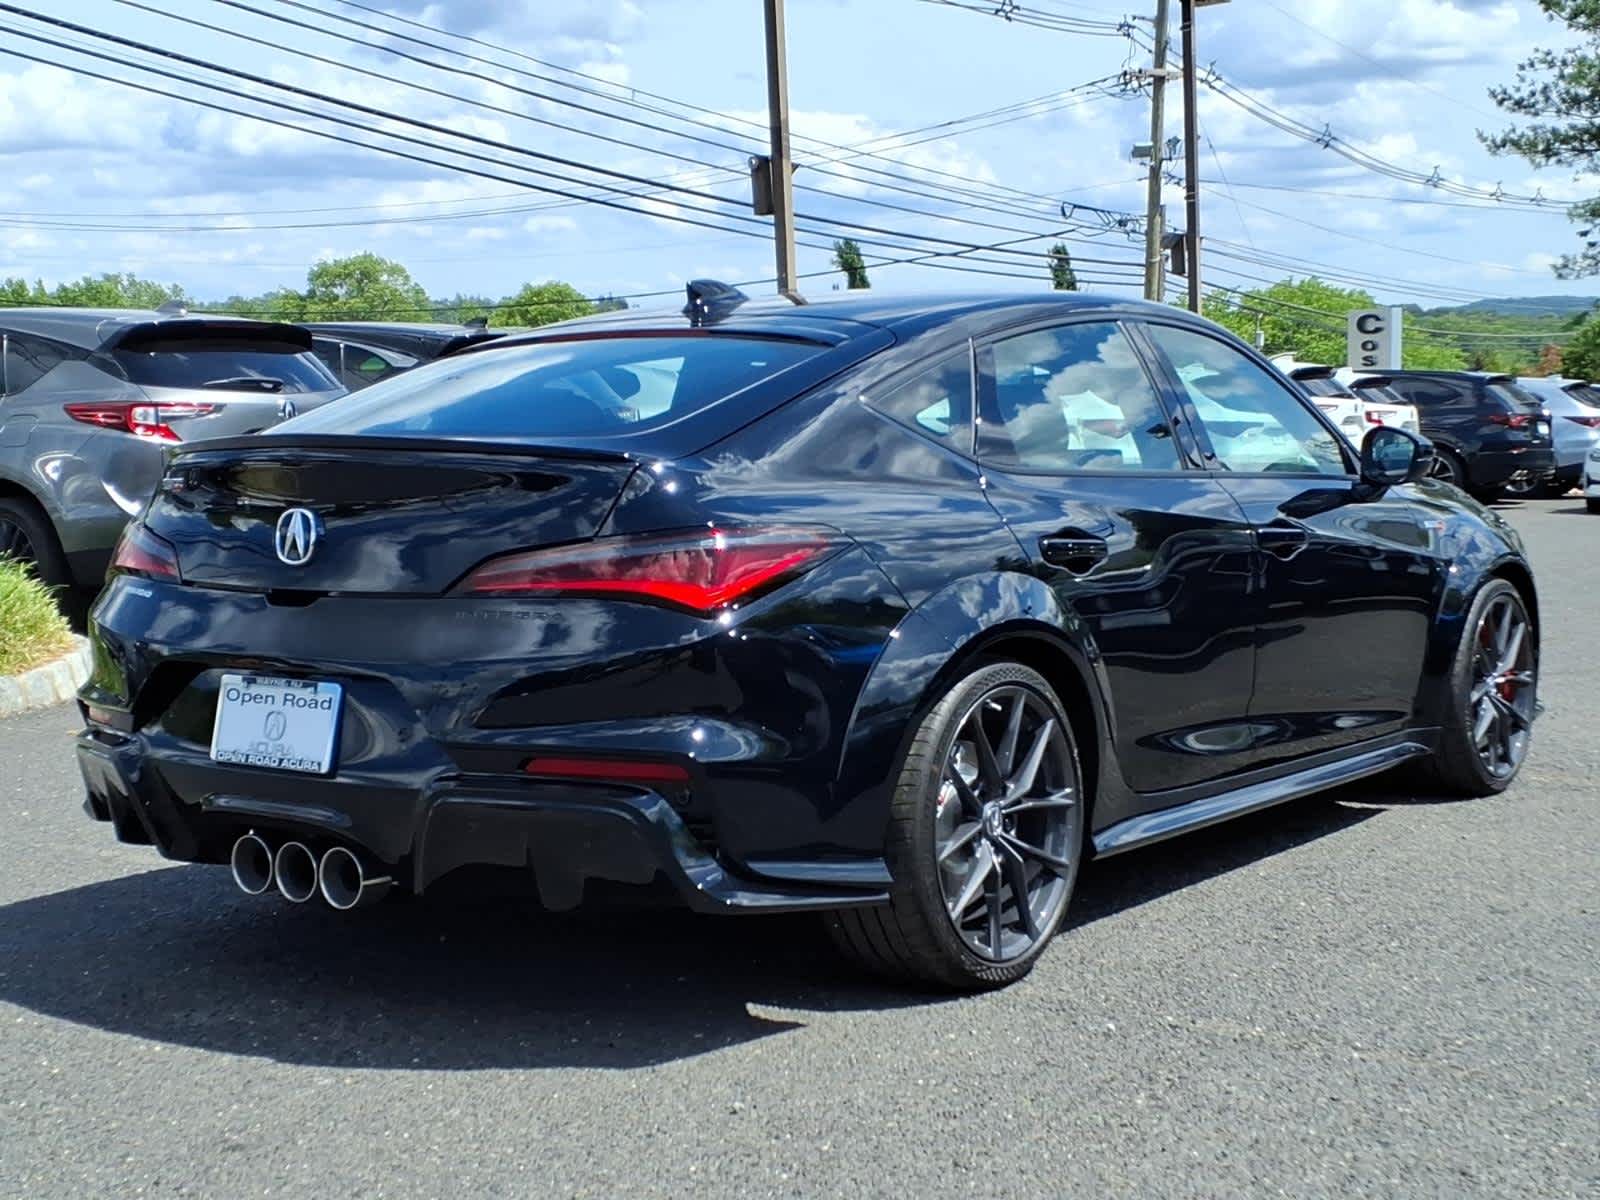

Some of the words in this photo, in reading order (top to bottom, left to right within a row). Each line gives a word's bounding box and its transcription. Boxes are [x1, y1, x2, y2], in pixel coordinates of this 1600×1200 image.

[226, 688, 276, 706] Open
[282, 693, 333, 711] Road
[217, 751, 246, 762] OPEN
[248, 755, 279, 767] ROAD
[281, 758, 320, 771] ACURA
